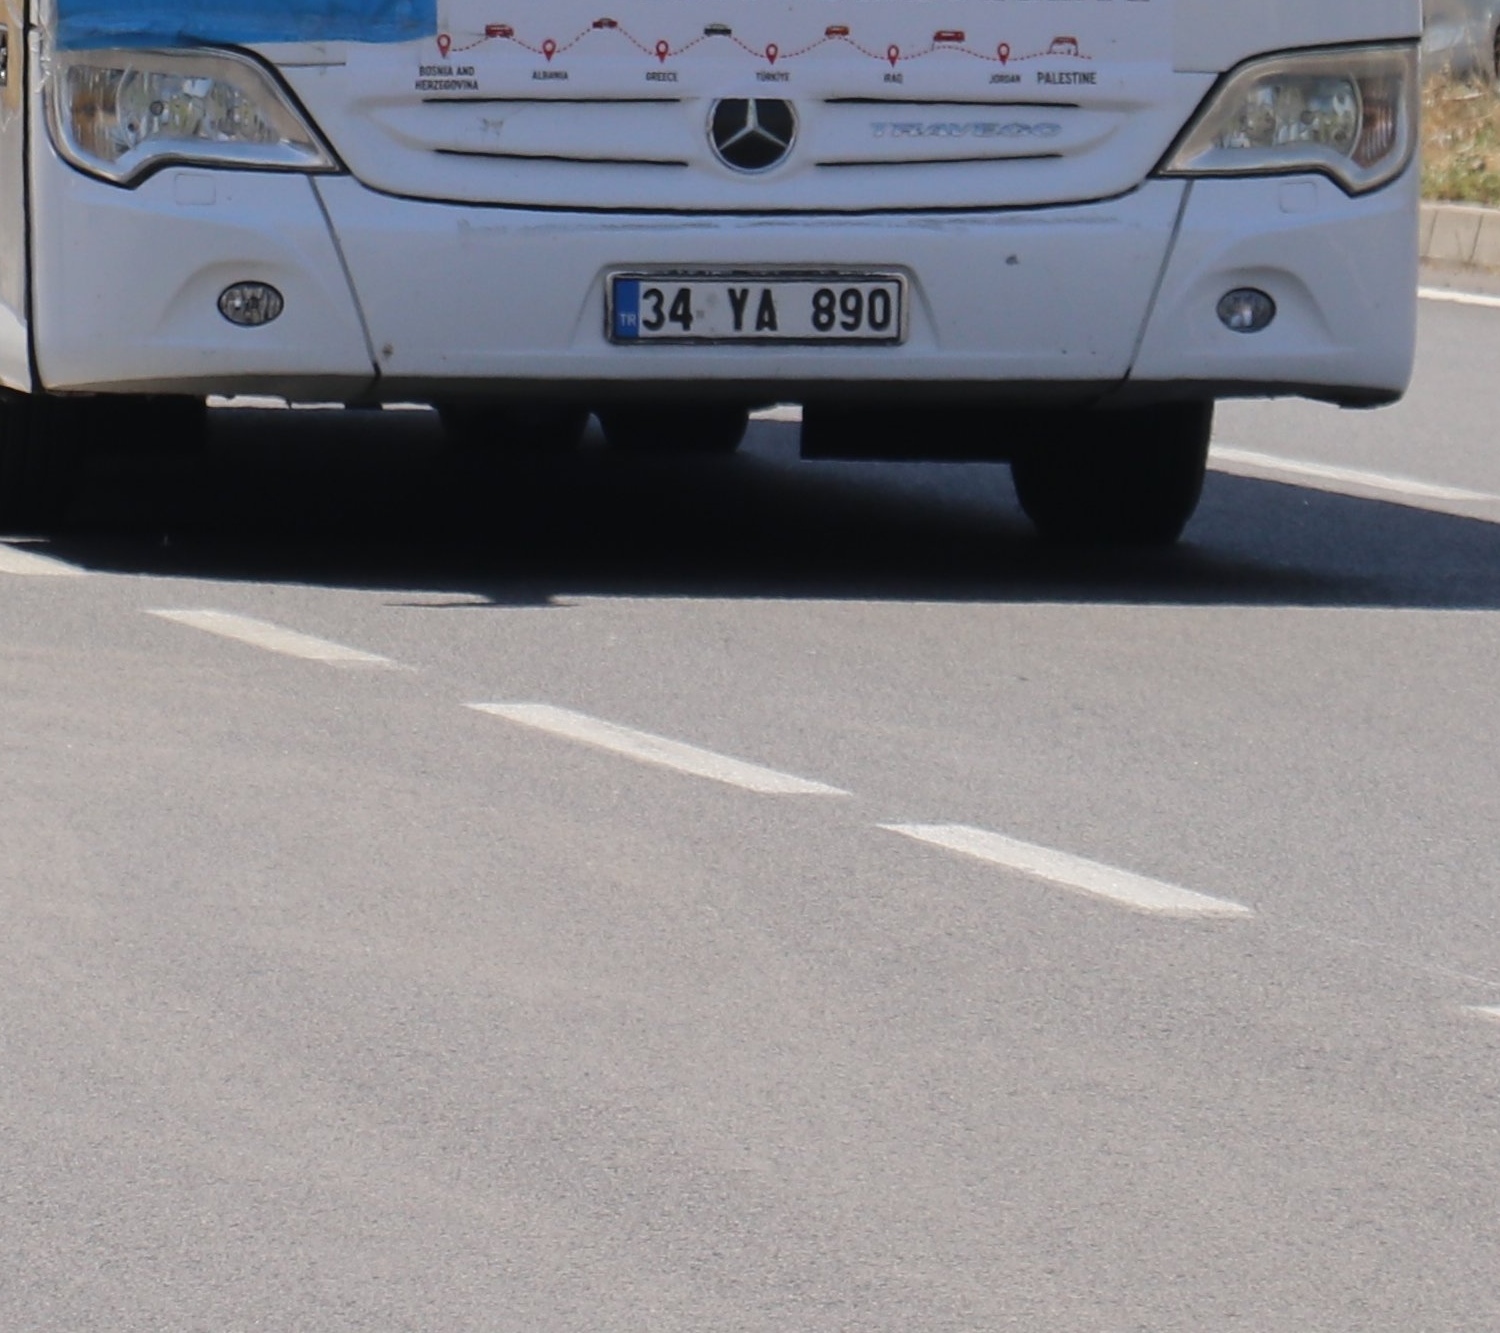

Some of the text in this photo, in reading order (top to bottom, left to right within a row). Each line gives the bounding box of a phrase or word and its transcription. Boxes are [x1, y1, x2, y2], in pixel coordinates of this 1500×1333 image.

[418, 65, 475, 77] BOSNIA AND
[531, 70, 569, 81] ALBANIA
[645, 71, 678, 83] GREECE
[883, 72, 903, 84] IRAQ
[988, 73, 1021, 84] JORDAN
[1036, 71, 1097, 85] PALESTINE
[414, 79, 479, 91] HERZEGOVINA
[619, 288, 891, 332] TR 34 YA 890
